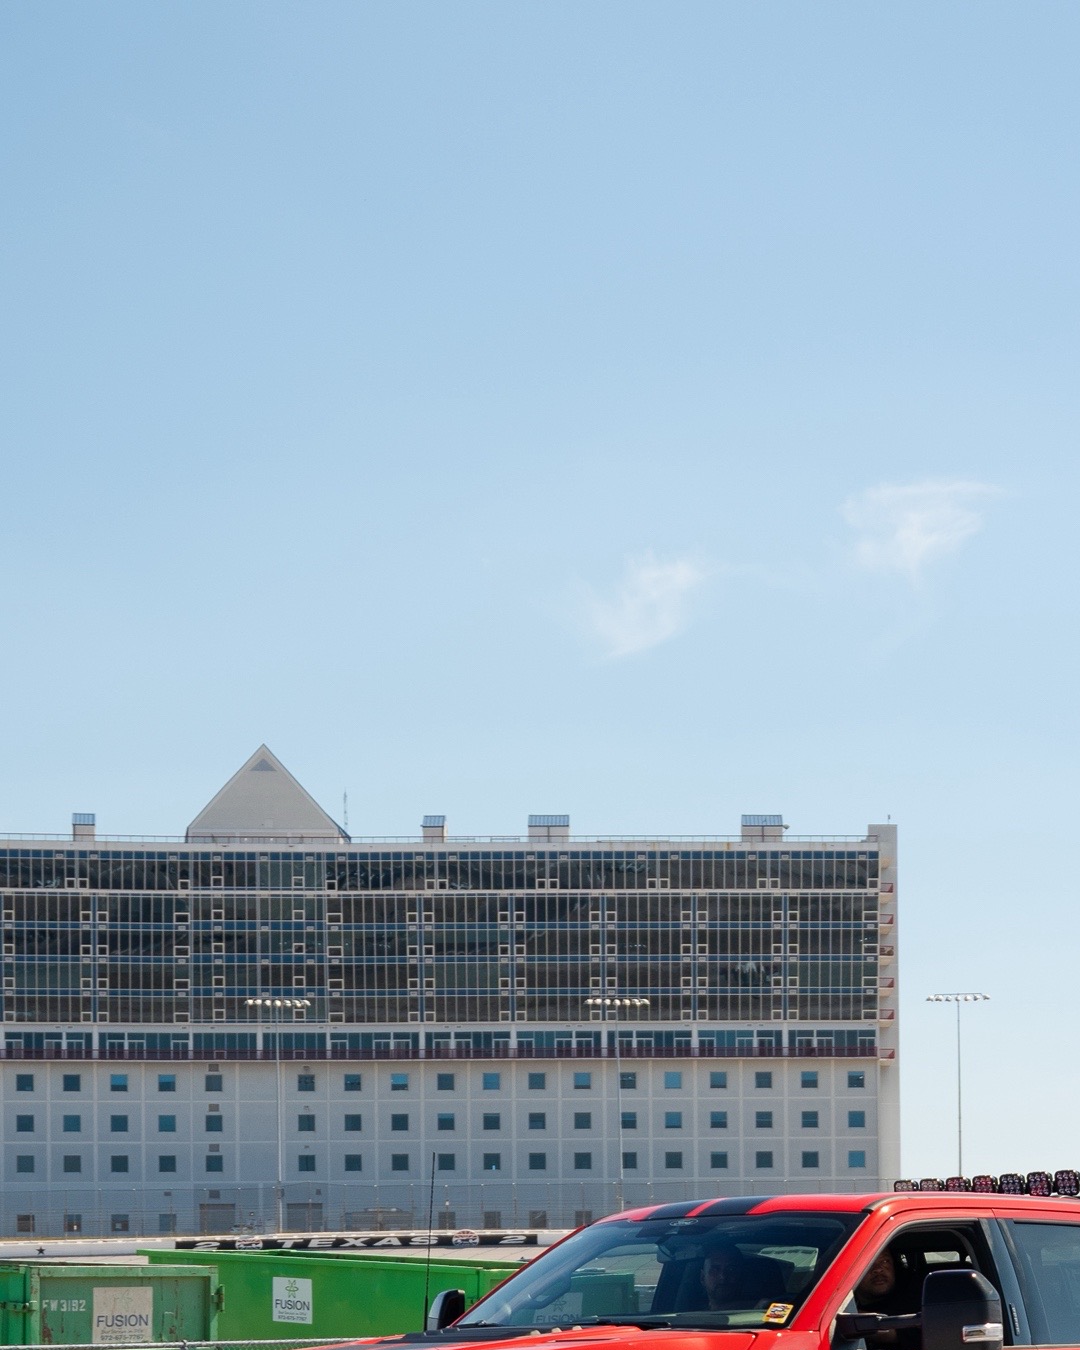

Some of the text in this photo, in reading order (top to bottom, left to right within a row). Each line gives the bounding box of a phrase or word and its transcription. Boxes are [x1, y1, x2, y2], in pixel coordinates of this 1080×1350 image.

[193, 1234, 527, 1250] 2 TEXAS 2
[275, 1299, 310, 1311] FUSION
[96, 1314, 149, 1328] FUSION
